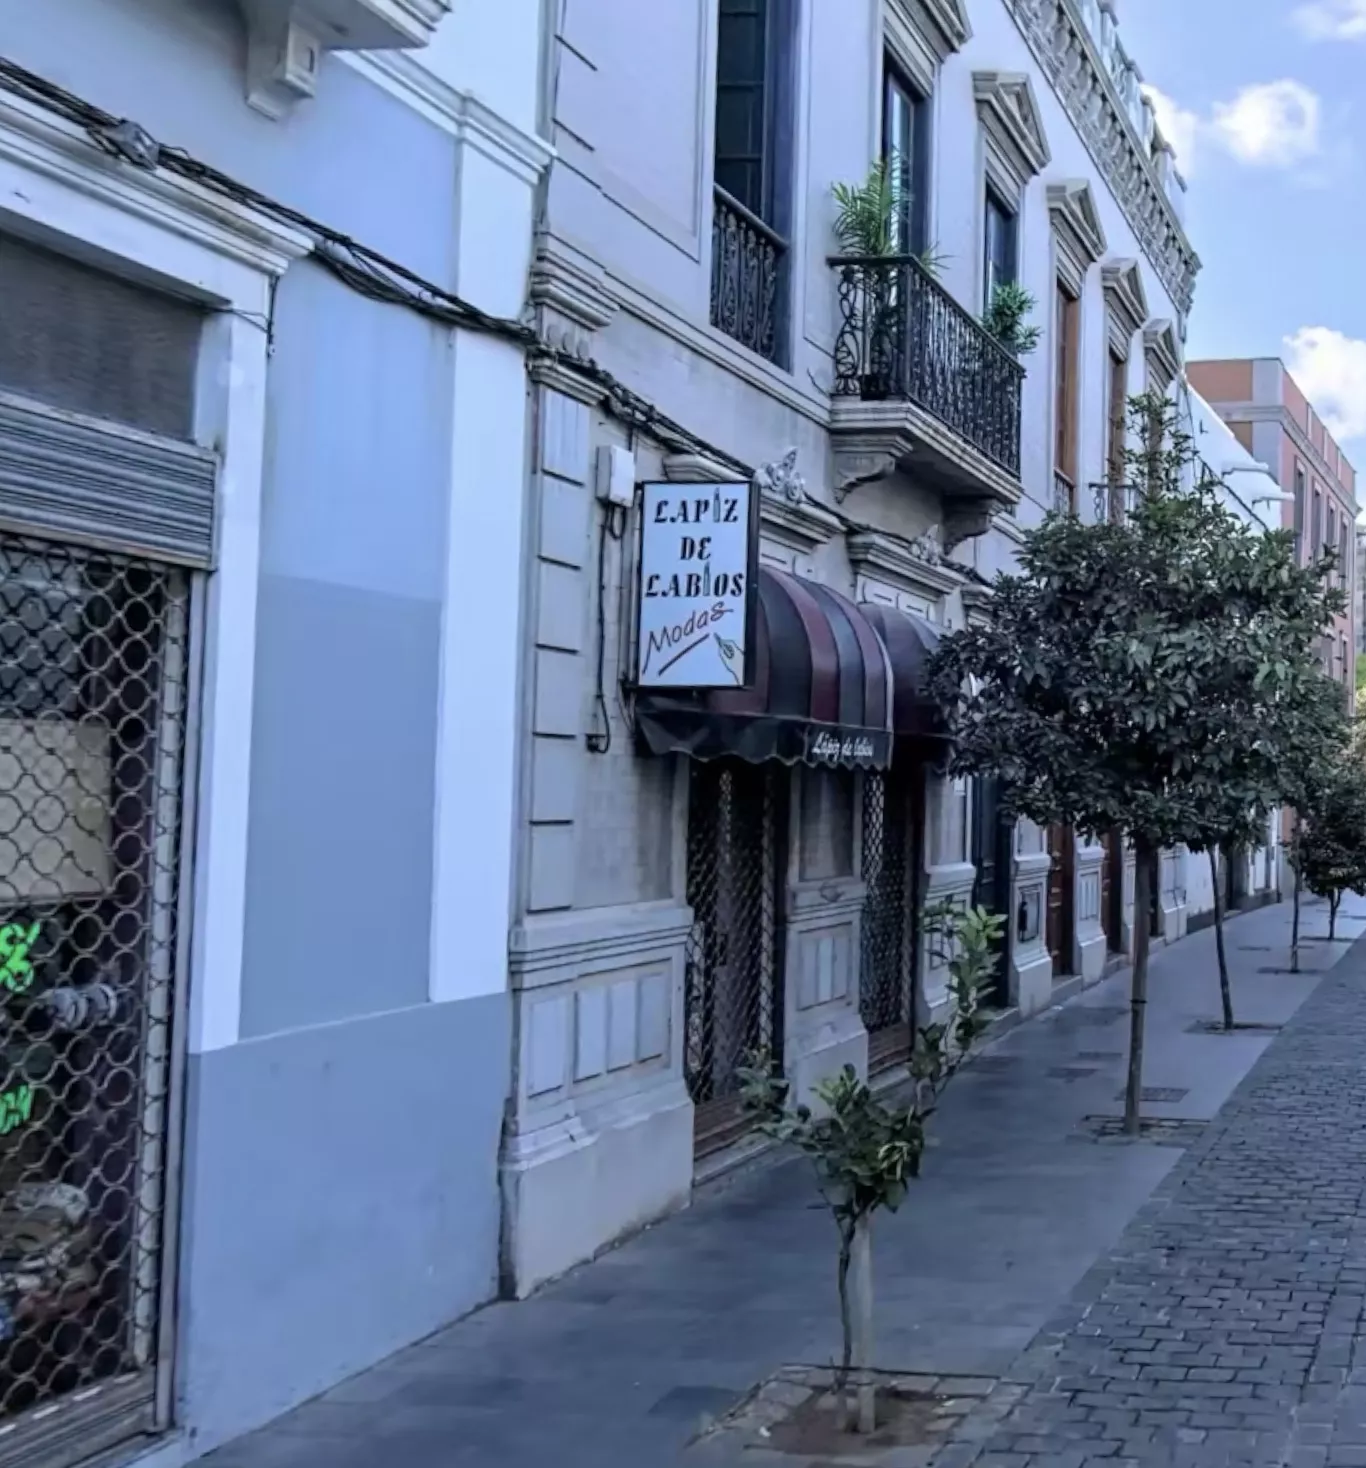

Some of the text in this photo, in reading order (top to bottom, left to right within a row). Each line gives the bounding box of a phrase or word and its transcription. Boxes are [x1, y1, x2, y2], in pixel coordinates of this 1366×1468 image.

[680, 536, 713, 561] DE
[645, 562, 745, 598] LABIOS
[642, 601, 734, 675] Modas
